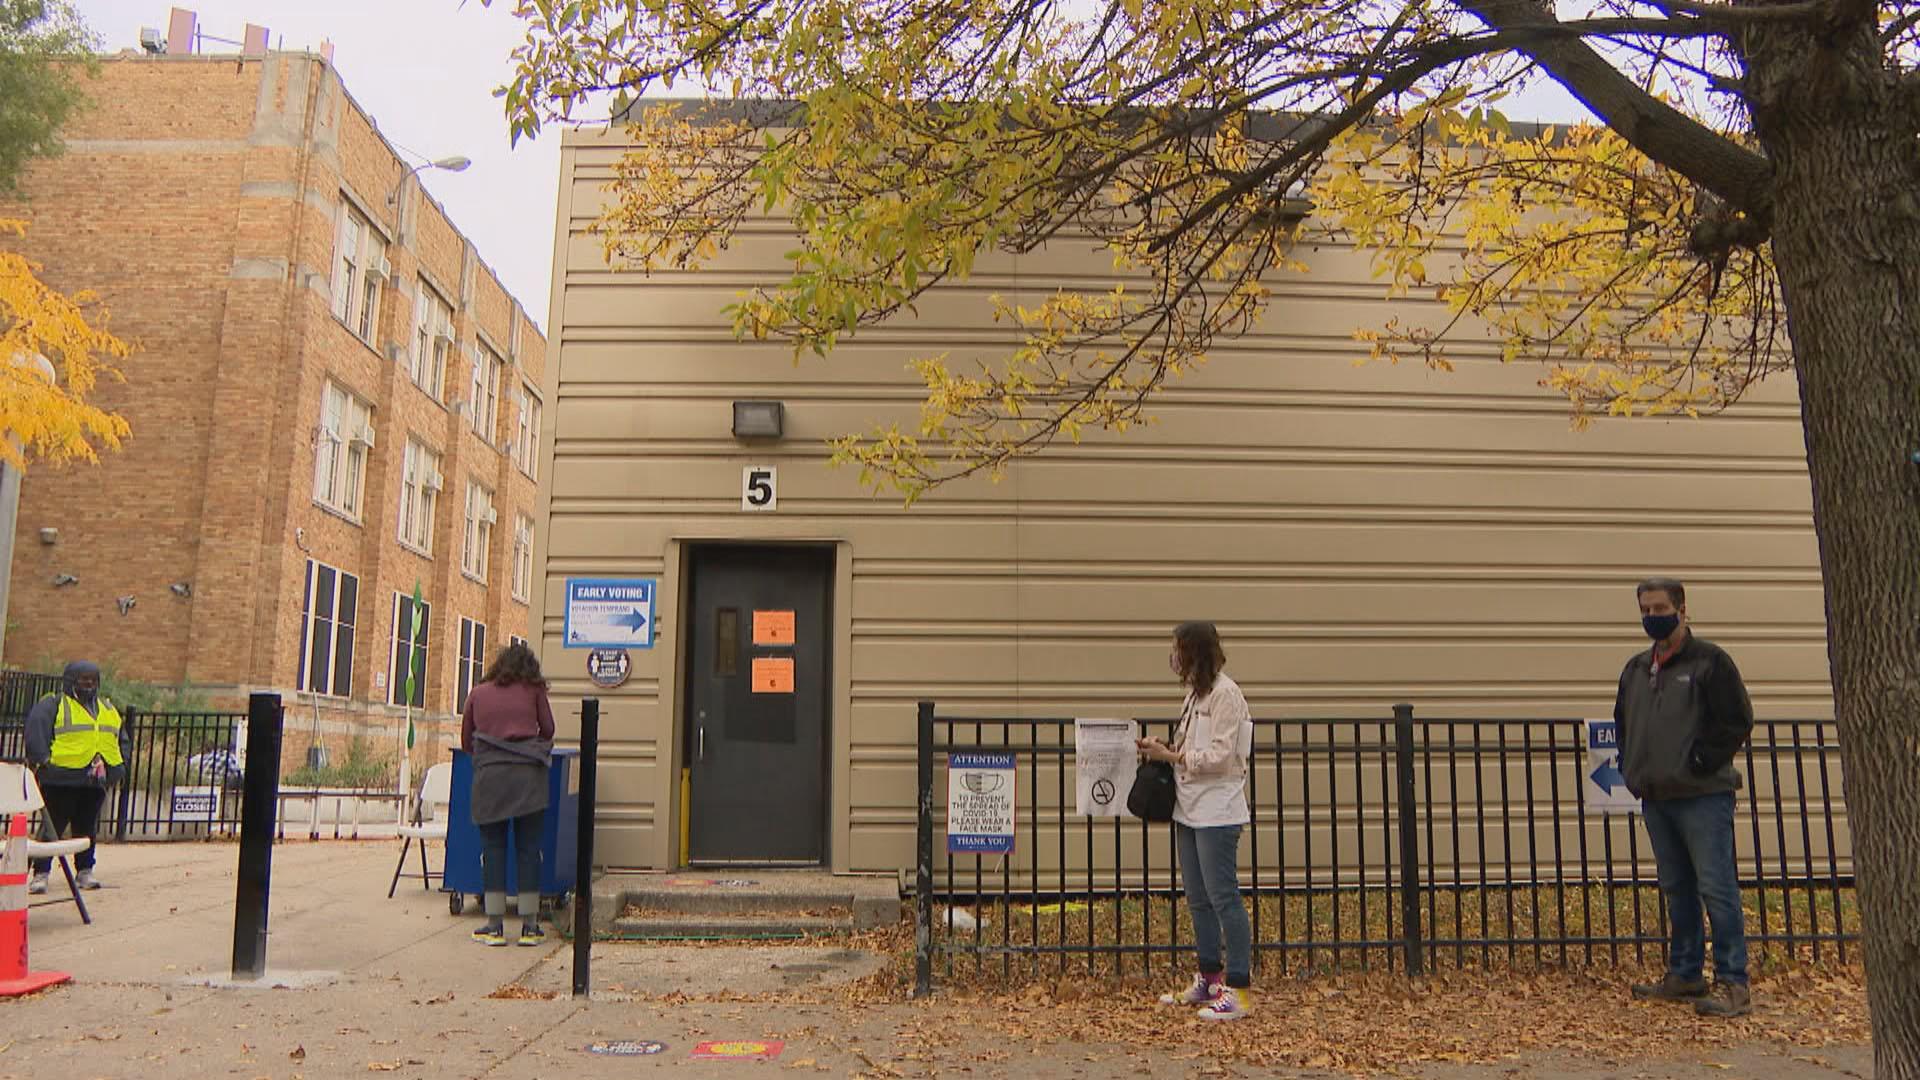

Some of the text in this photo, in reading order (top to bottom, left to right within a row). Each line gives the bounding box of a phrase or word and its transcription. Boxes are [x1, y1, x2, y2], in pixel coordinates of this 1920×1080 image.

[747, 471, 772, 505] 5
[577, 587, 643, 598] EARLY VOTING
[1597, 729, 1616, 743] EA
[954, 755, 1010, 764] ATTENTION
[969, 802, 999, 810] SPREAD
[951, 817, 980, 825] PLEASE
[982, 817, 1004, 825] WEAR
[956, 837, 1005, 845] THANK YOU
